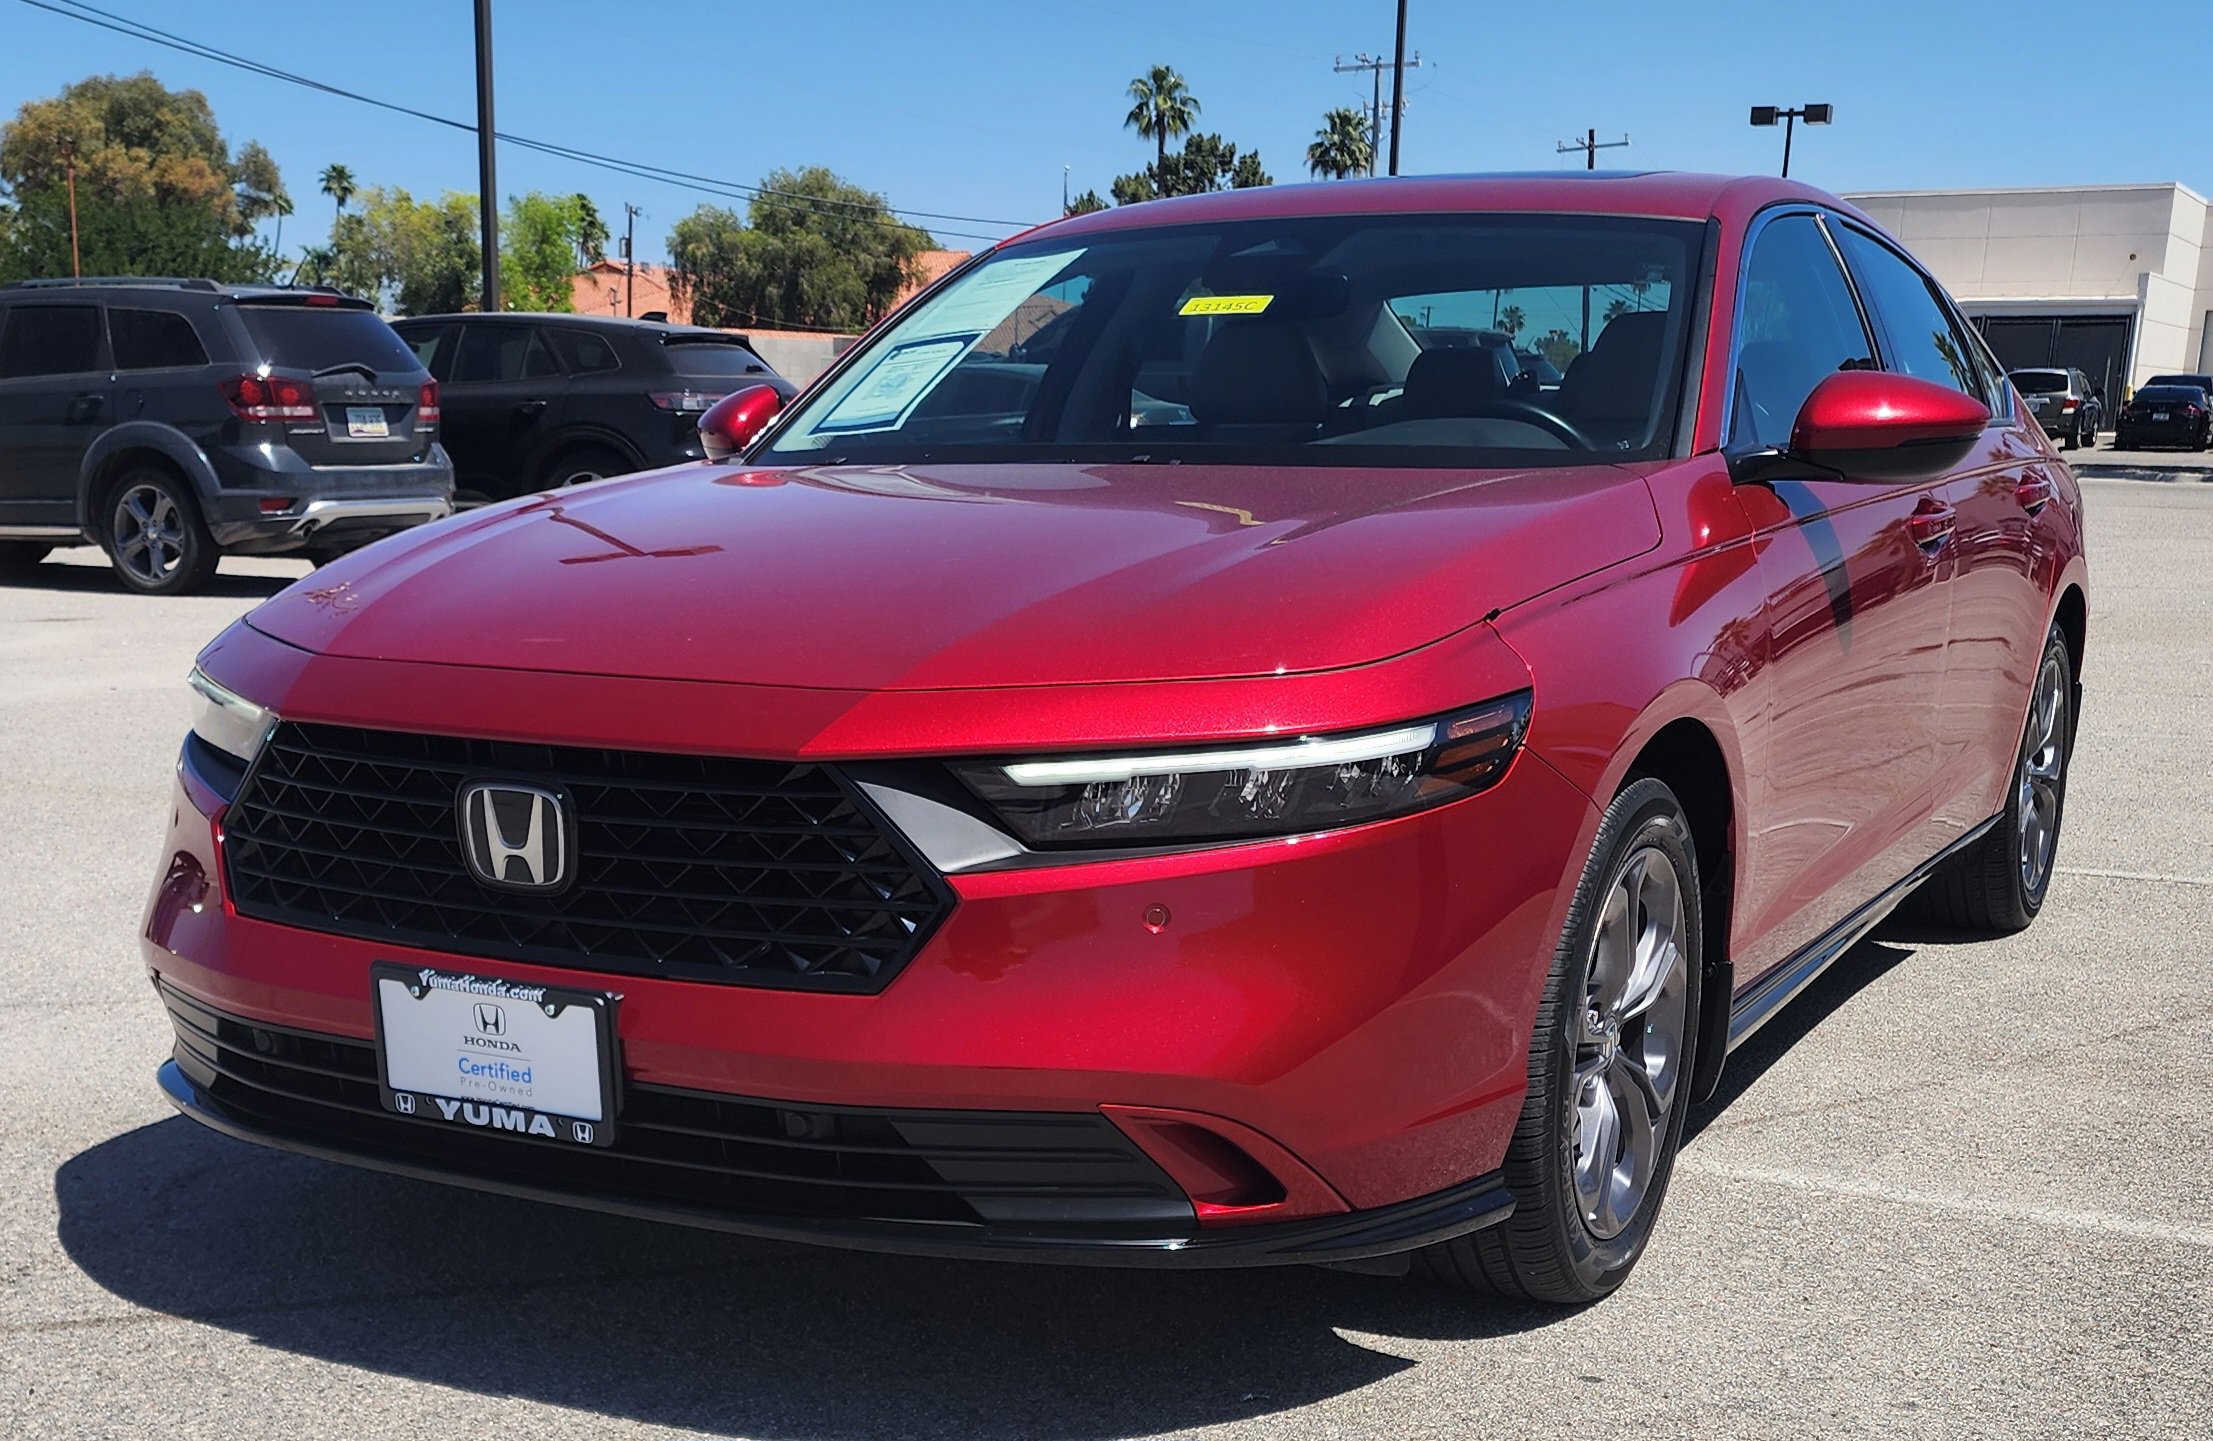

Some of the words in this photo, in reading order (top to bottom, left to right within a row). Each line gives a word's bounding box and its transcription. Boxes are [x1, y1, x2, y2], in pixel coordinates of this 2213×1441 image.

[1190, 301, 1258, 312] 13145C
[419, 969, 546, 1002] YumaHonda.com
[463, 1035, 522, 1053] HONDA
[458, 1057, 532, 1084] Certified
[460, 1076, 533, 1098] Pre-Owned
[435, 1098, 556, 1138] YUMA
[1559, 1135, 1581, 1243] KINERGY
